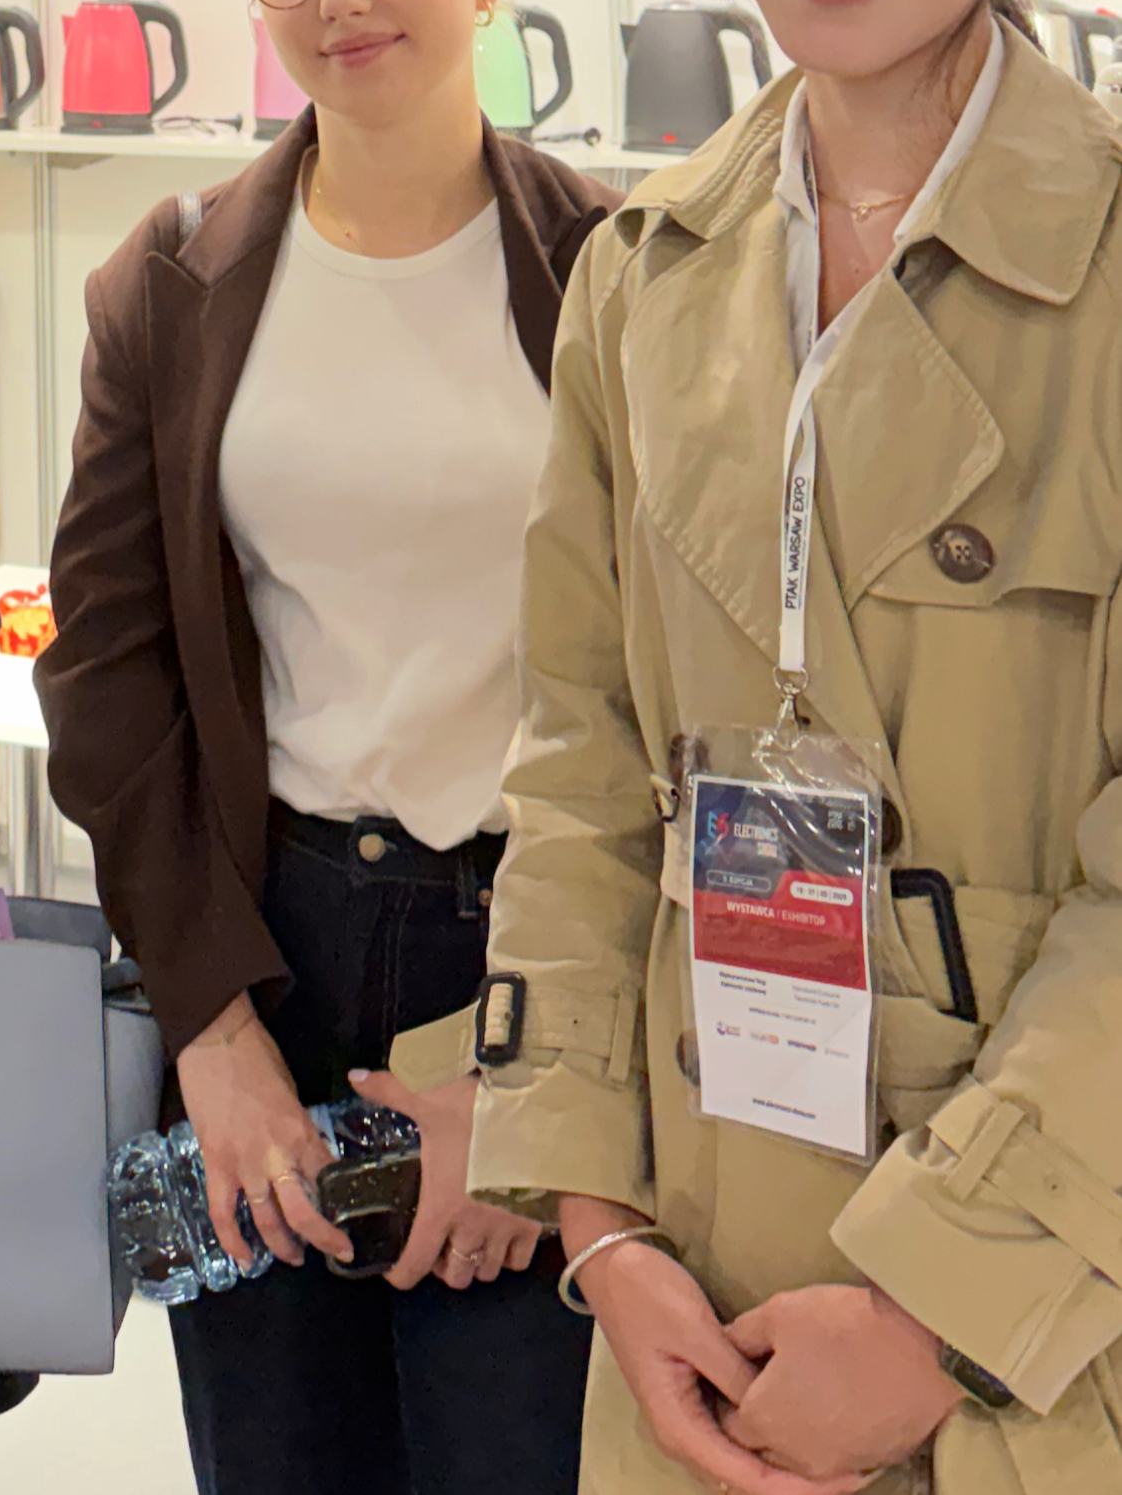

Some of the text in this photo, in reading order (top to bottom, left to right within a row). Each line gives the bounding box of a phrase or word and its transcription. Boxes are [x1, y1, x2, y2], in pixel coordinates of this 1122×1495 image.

[792, 476, 806, 513] EXPO
[788, 515, 803, 572] WARSAW
[785, 577, 799, 610] PTAK
[734, 823, 778, 841] ELECTRONICS
[727, 901, 774, 919] WYSTAWCA
[782, 909, 825, 926] EXHIBITOR
